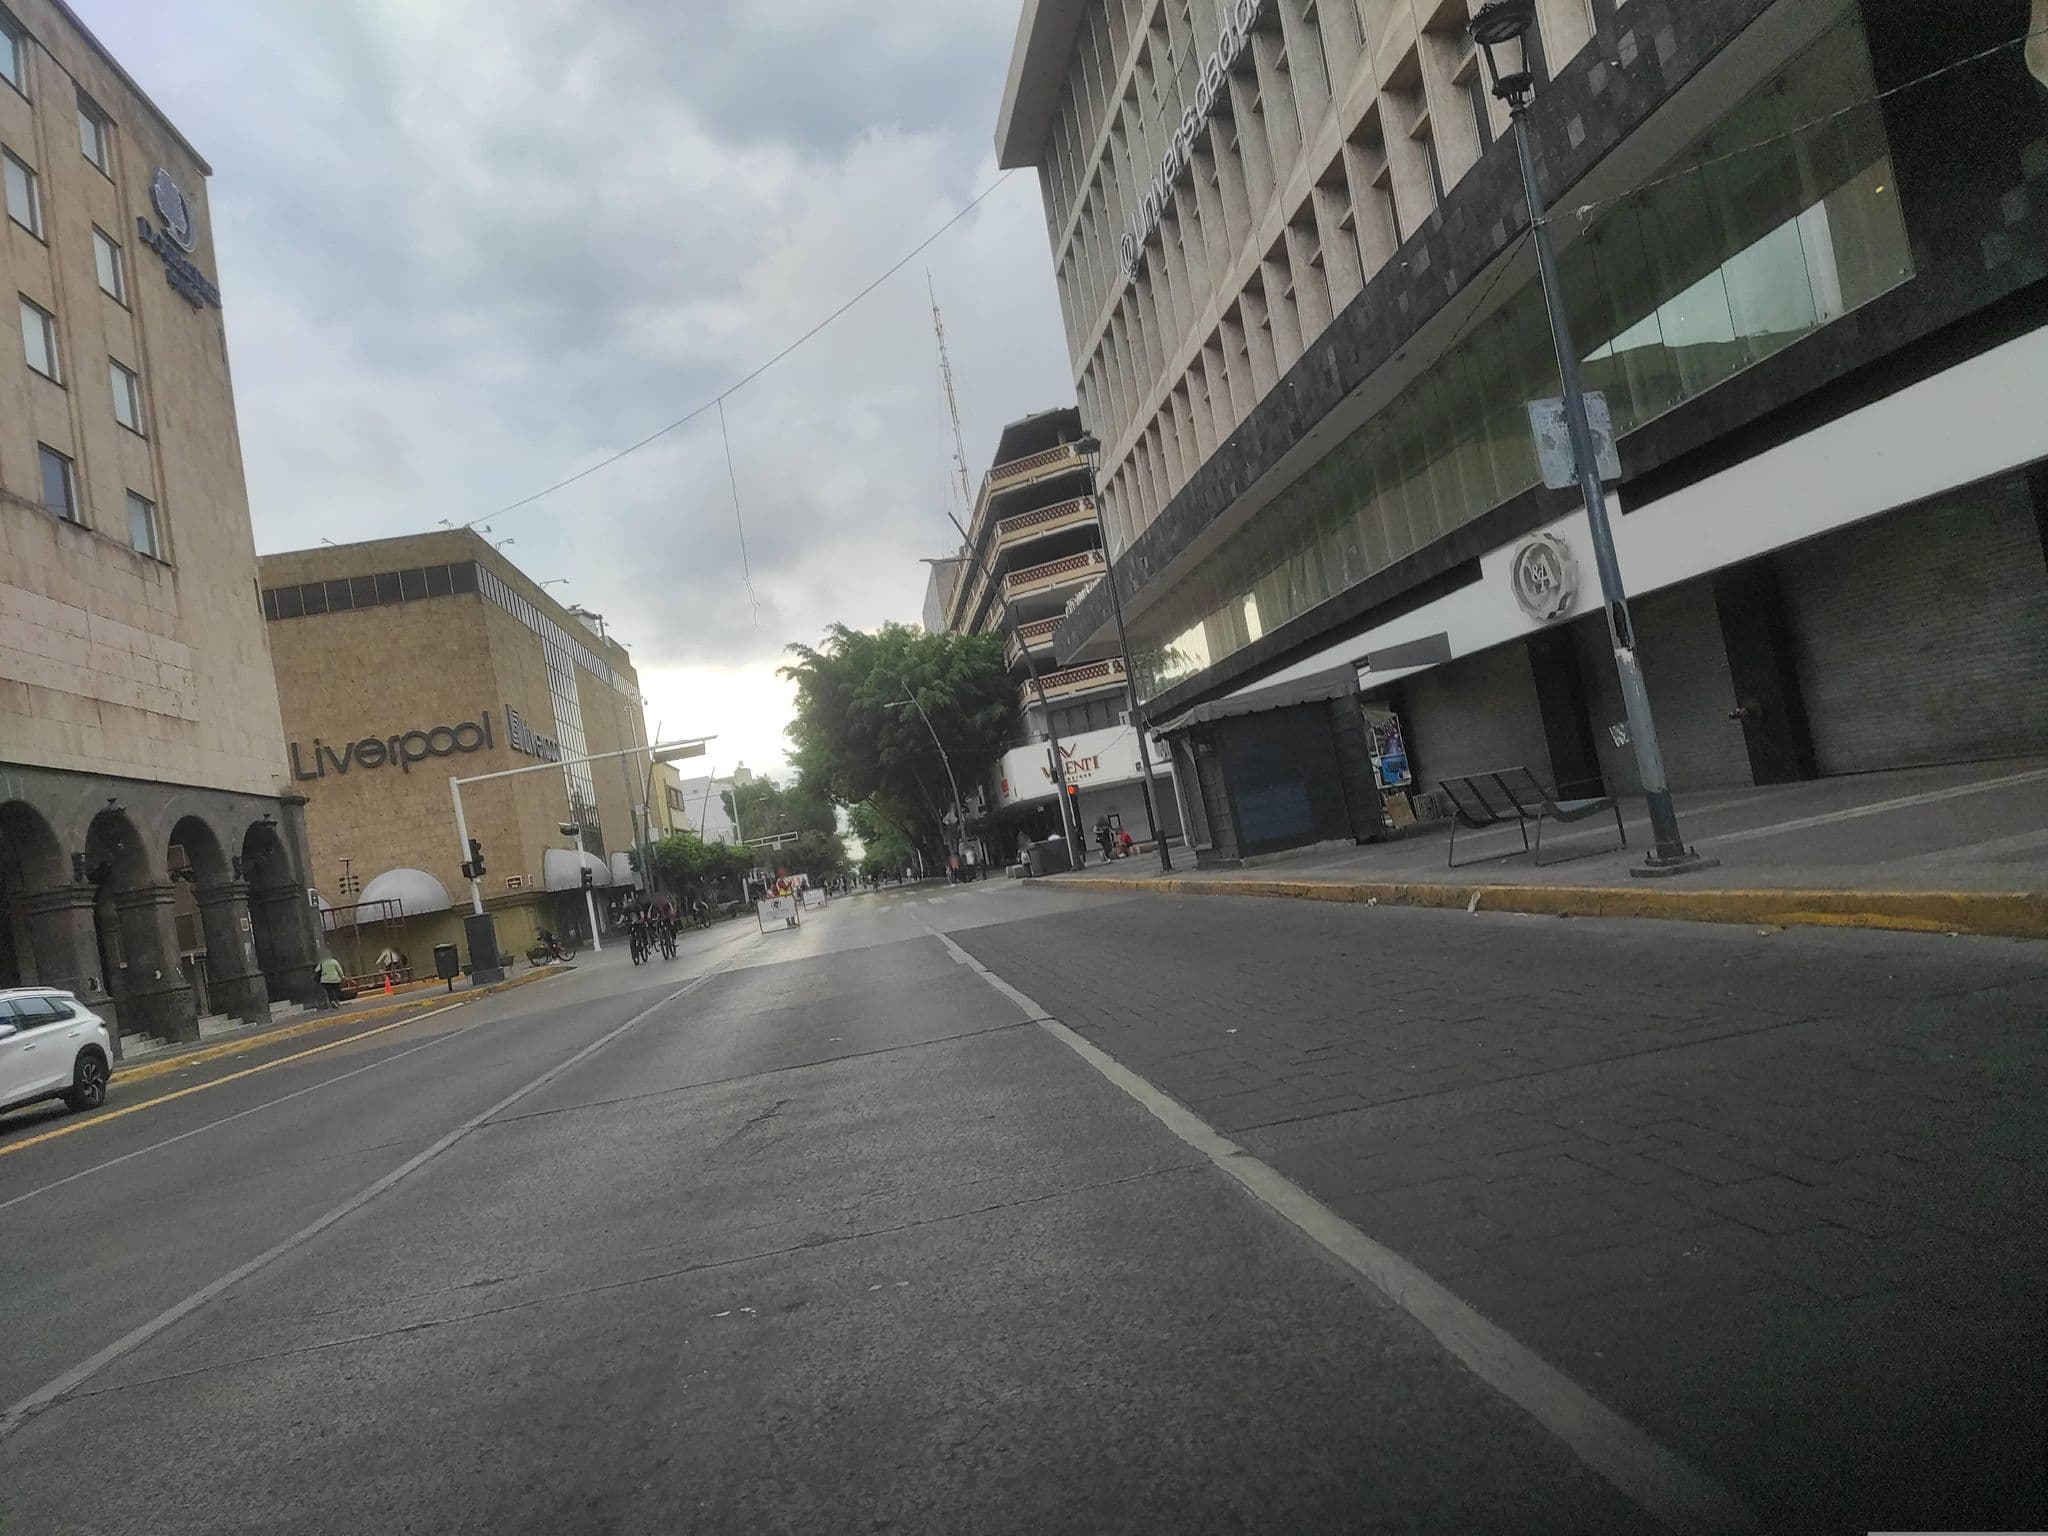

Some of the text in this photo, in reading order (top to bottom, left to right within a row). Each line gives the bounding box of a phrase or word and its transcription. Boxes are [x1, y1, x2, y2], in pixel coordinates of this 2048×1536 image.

[1131, 7, 1234, 243] Universdad
[290, 710, 494, 782] Liverpool
[1040, 755, 1100, 779] VENTI
